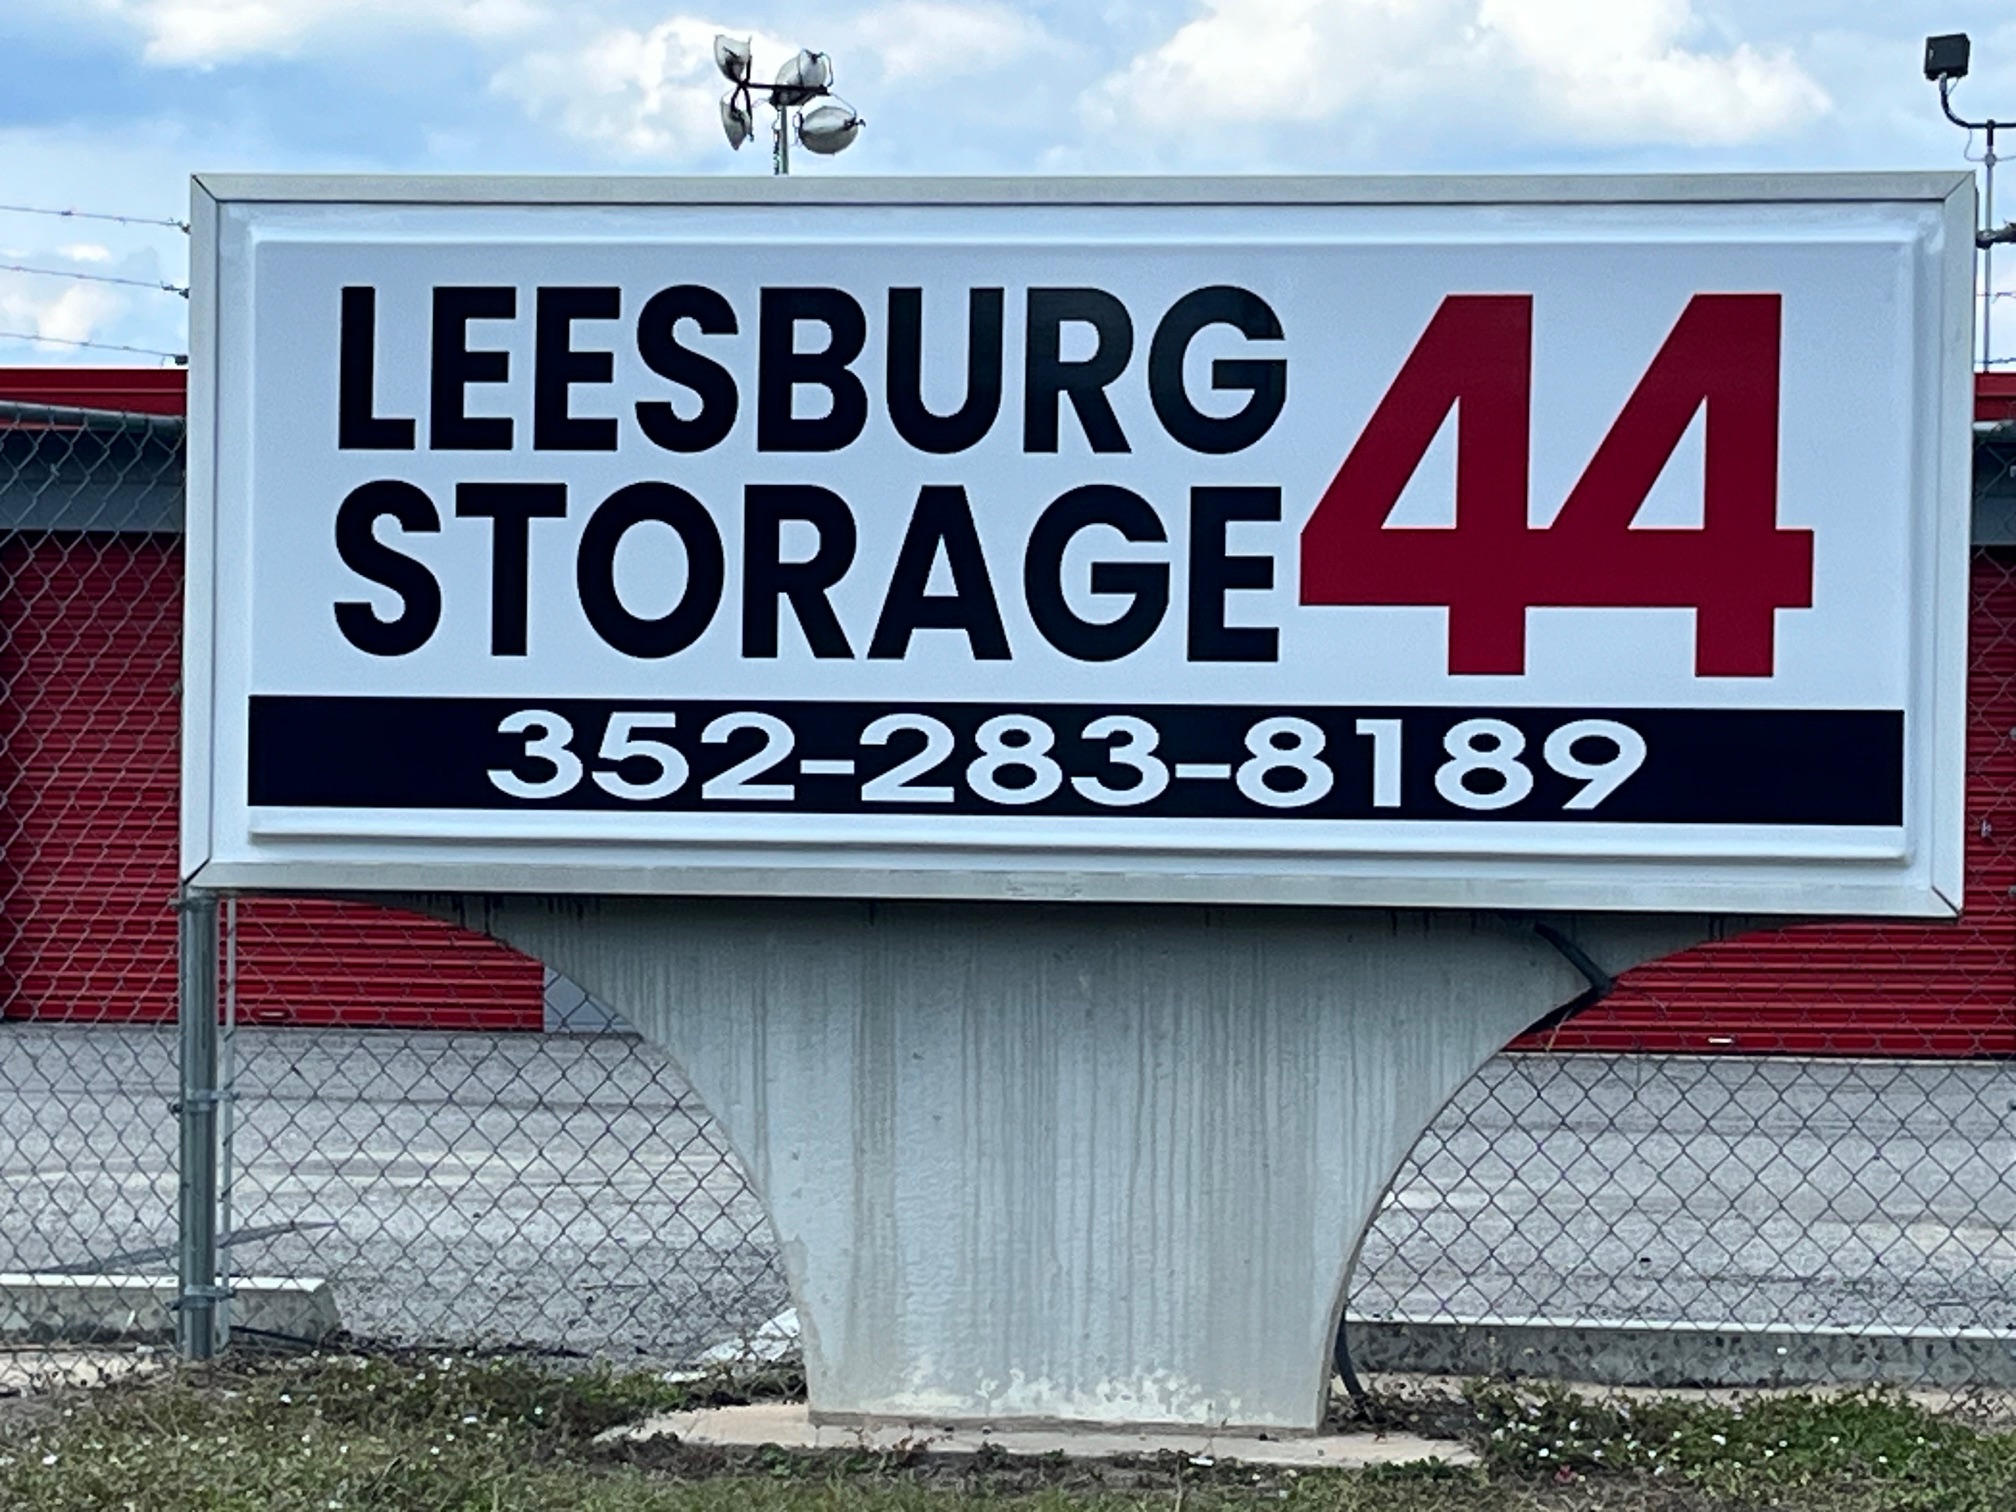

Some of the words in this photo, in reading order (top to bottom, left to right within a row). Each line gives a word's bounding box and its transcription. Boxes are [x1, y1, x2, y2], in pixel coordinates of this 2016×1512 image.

[339, 286, 1287, 454] LEESBURG
[334, 480, 1282, 663] STORAGE
[1300, 294, 1814, 677] 44
[487, 709, 1647, 810] 352-283-8189
